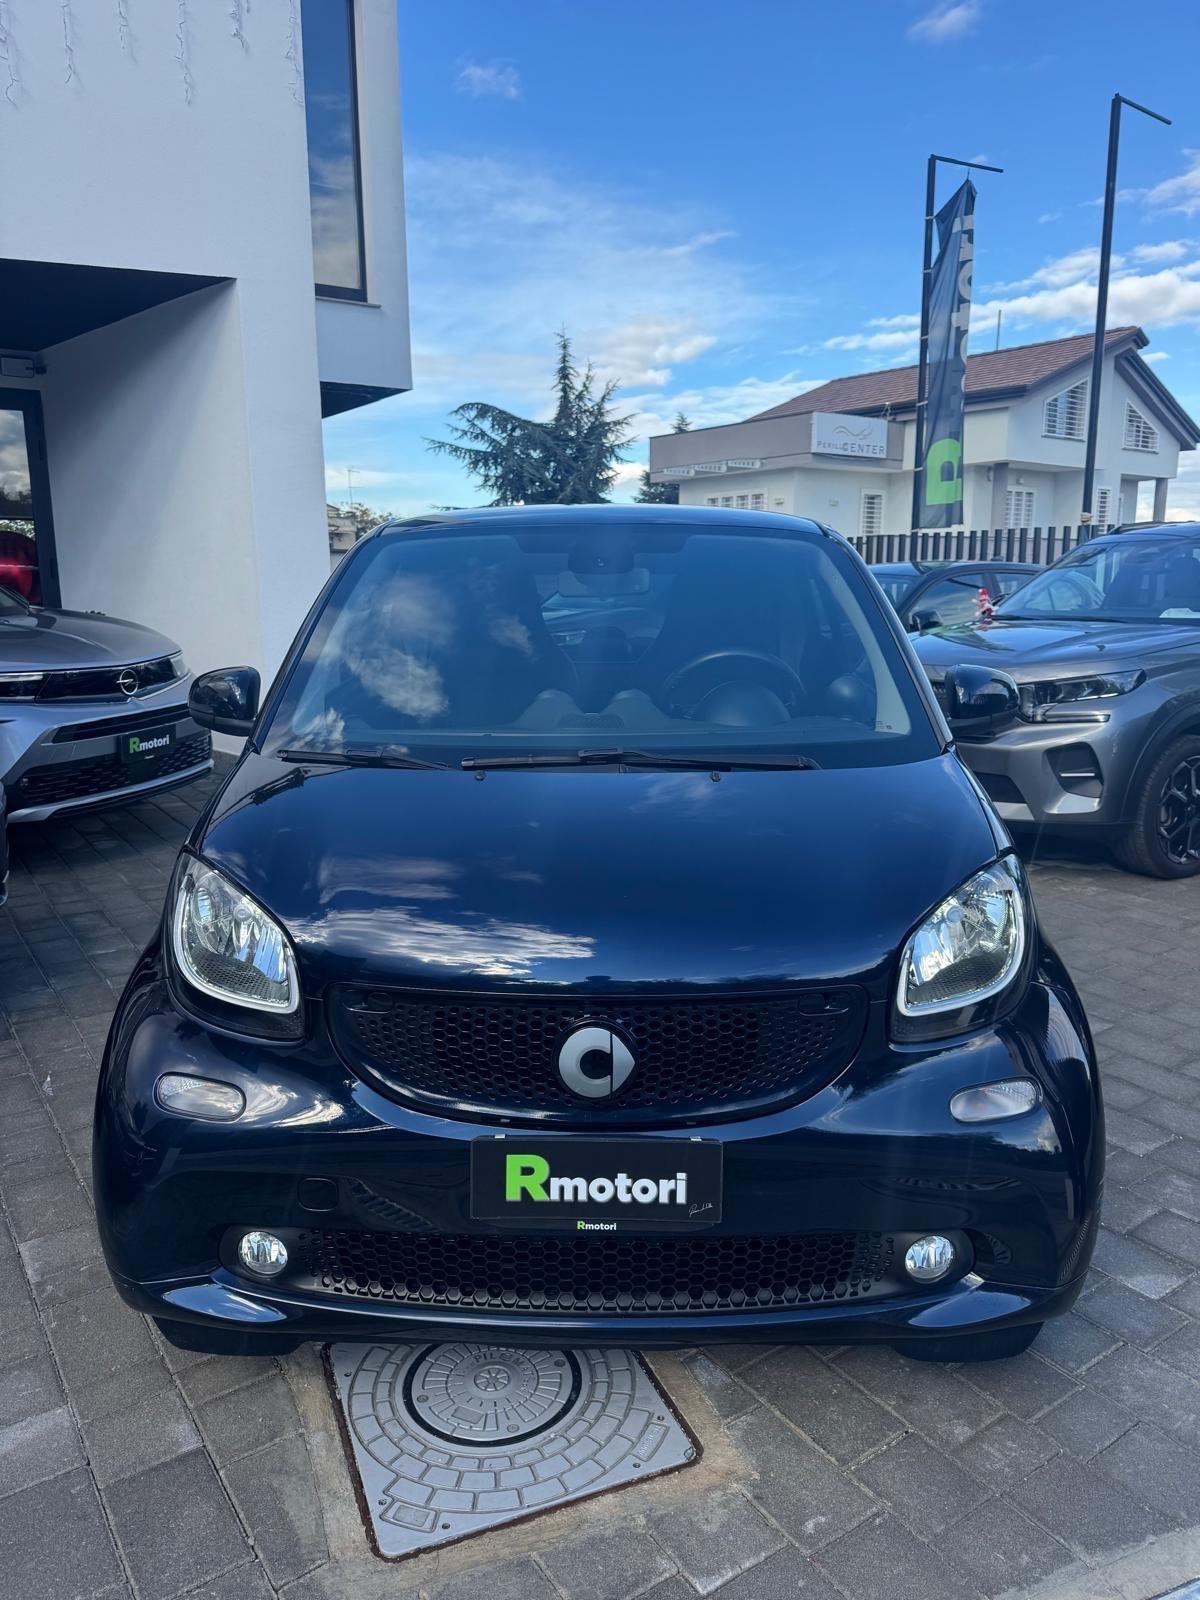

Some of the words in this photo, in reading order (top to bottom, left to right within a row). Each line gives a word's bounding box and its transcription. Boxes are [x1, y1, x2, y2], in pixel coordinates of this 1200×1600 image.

[129, 734, 170, 753] Rmotori
[505, 1154, 687, 1204] Rmotori
[577, 1220, 617, 1230] Rmotori
